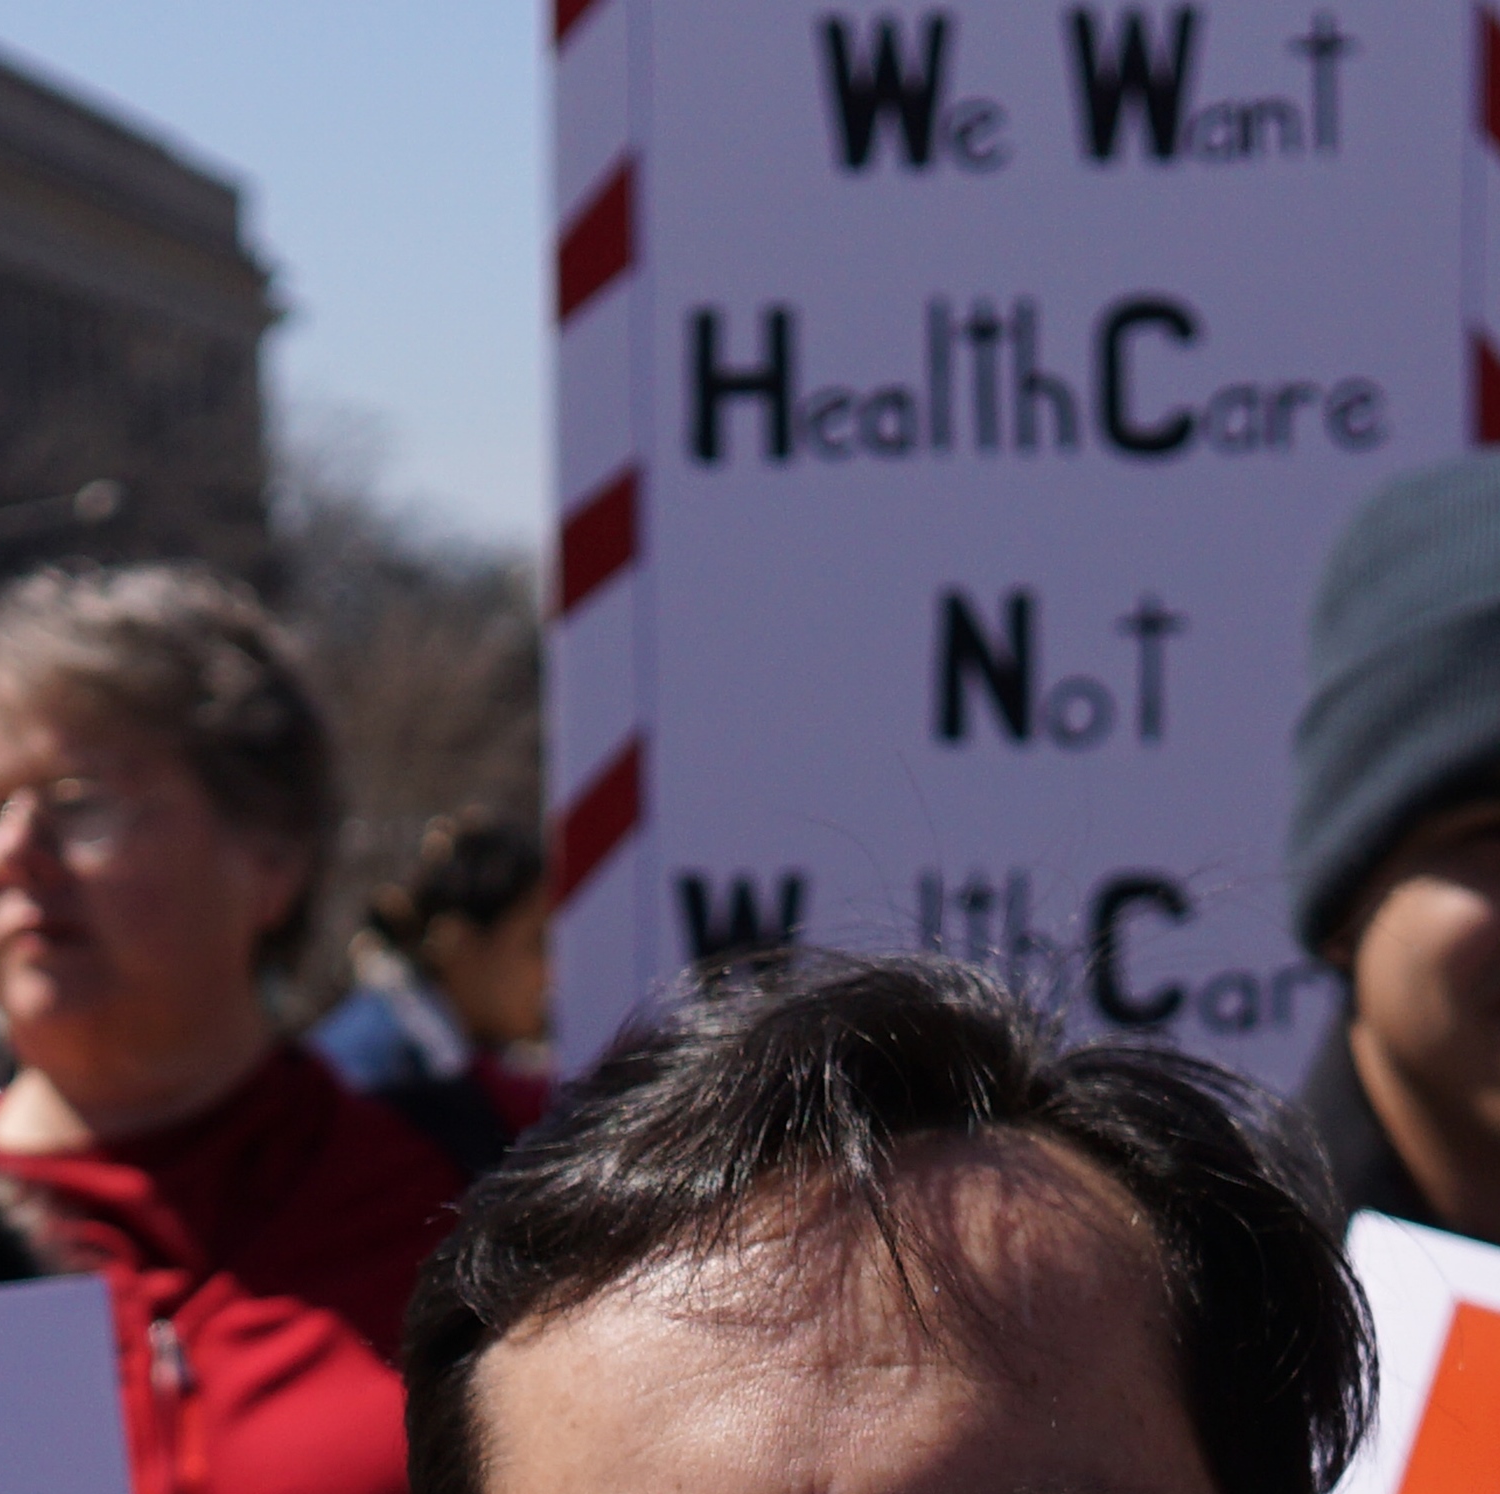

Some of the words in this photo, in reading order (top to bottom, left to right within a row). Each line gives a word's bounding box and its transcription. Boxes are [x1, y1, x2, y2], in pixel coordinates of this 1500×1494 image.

[817, 8, 1012, 176] We
[1063, 2, 1362, 168] Want
[682, 291, 1388, 471] HealthCare
[929, 584, 1188, 754] Not
